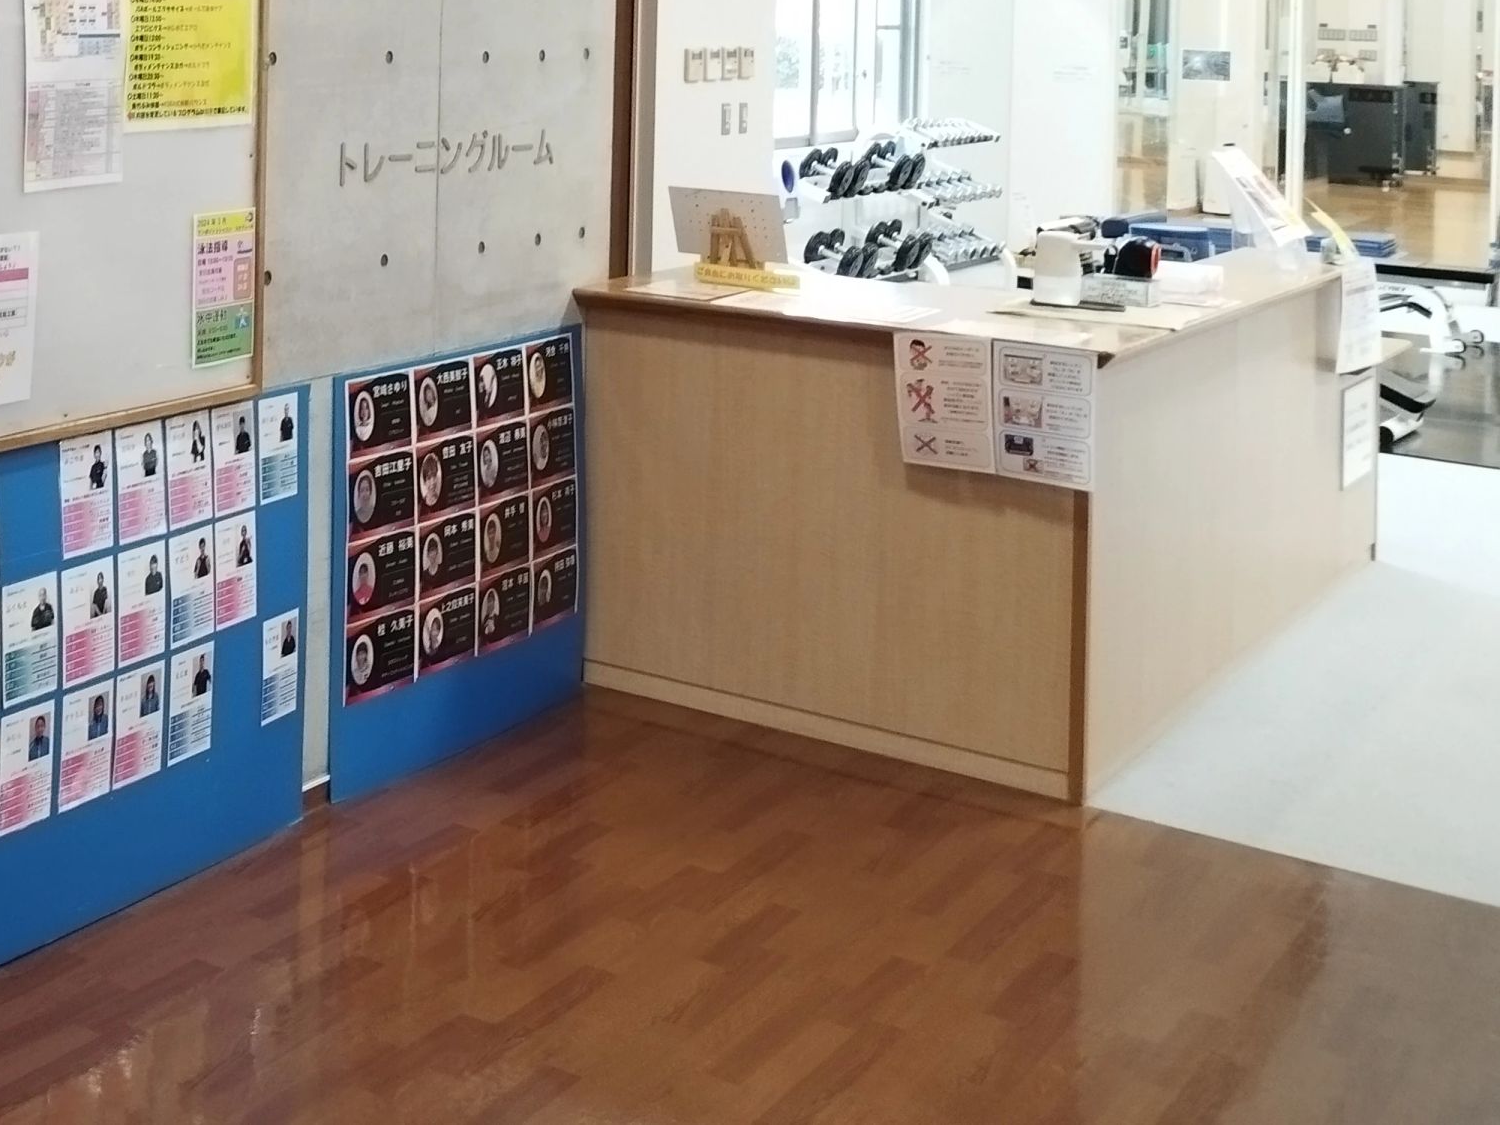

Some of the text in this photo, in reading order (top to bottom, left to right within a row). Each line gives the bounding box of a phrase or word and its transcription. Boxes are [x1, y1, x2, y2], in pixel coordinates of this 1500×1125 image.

[339, 129, 554, 187] トレーニングルーム
